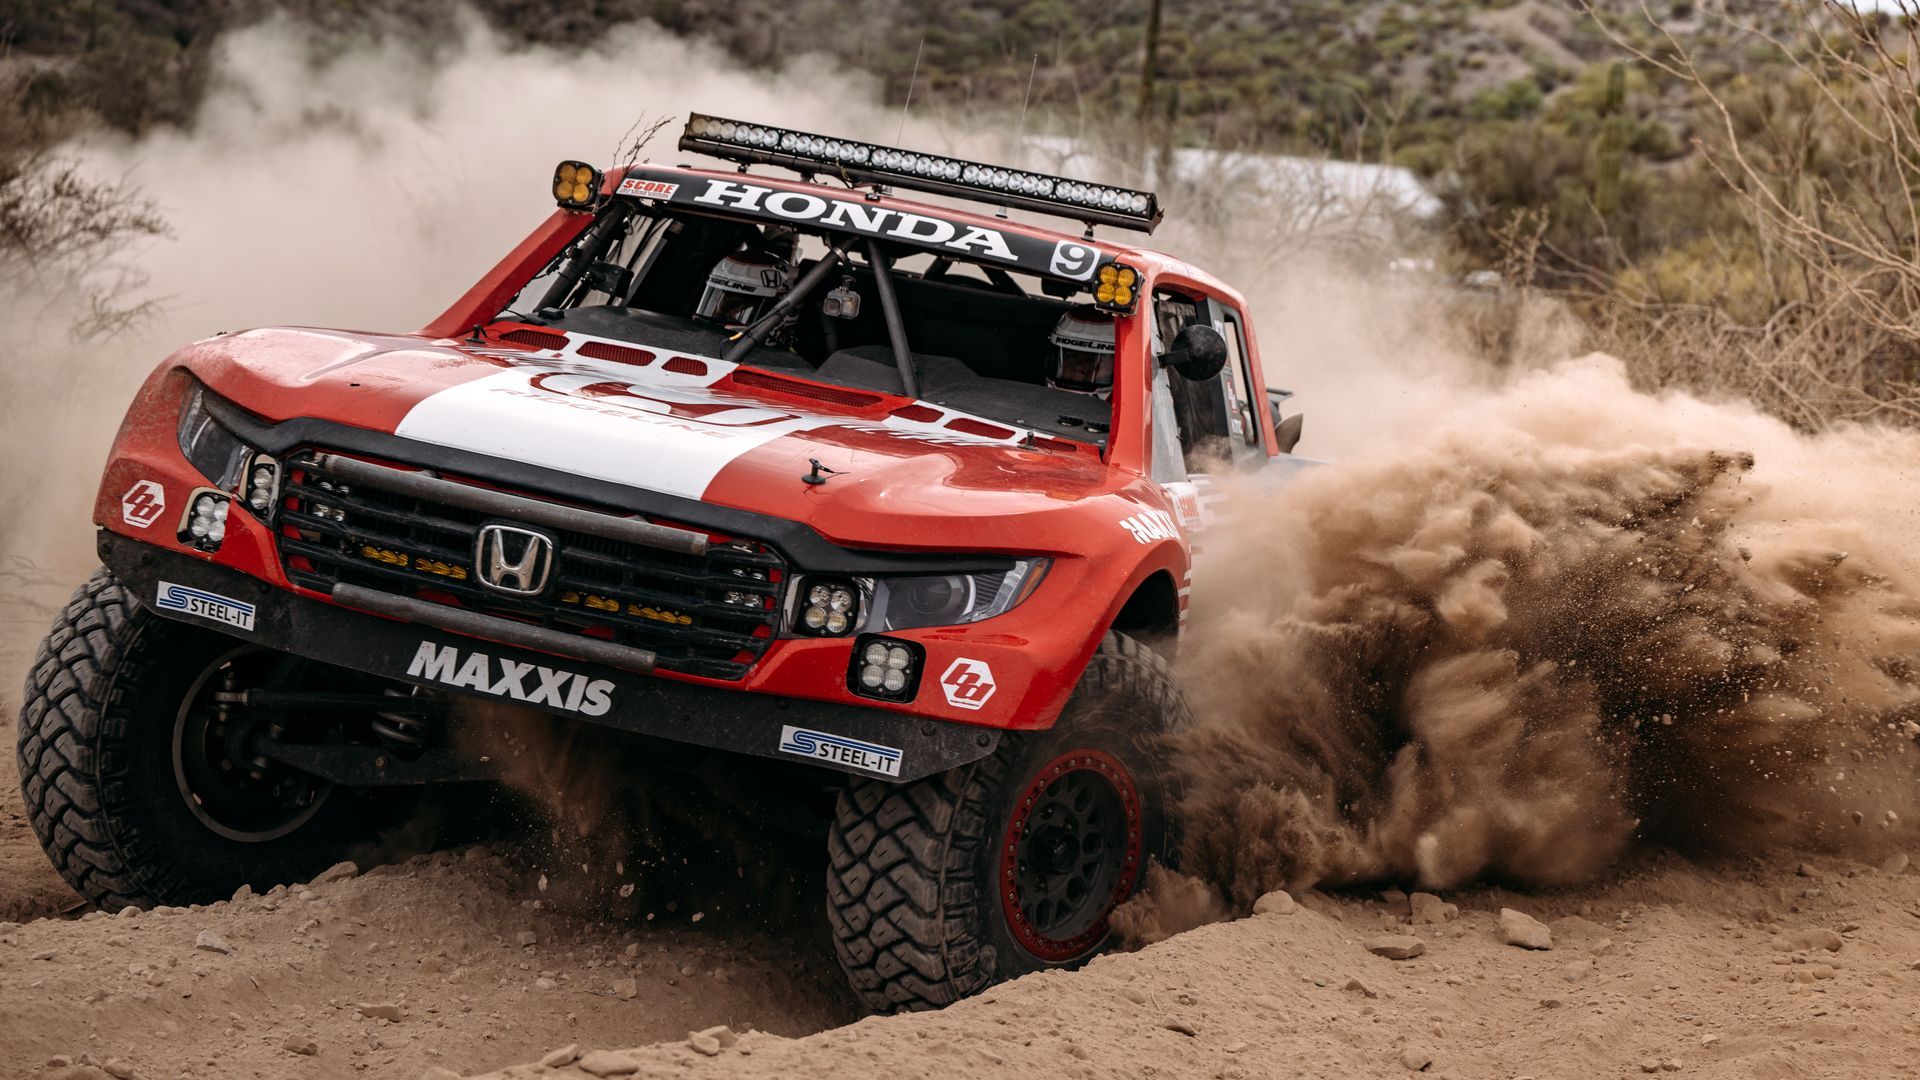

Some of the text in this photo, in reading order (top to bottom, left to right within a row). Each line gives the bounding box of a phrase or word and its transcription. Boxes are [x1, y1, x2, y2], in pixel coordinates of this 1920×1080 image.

[623, 180, 674, 195] SCORE
[695, 179, 1018, 261] HONDA
[1055, 242, 1094, 275] 9
[190, 600, 252, 627] STEEL-IT
[406, 641, 616, 718] MAXXIS
[818, 742, 897, 772] STEEL-IT
